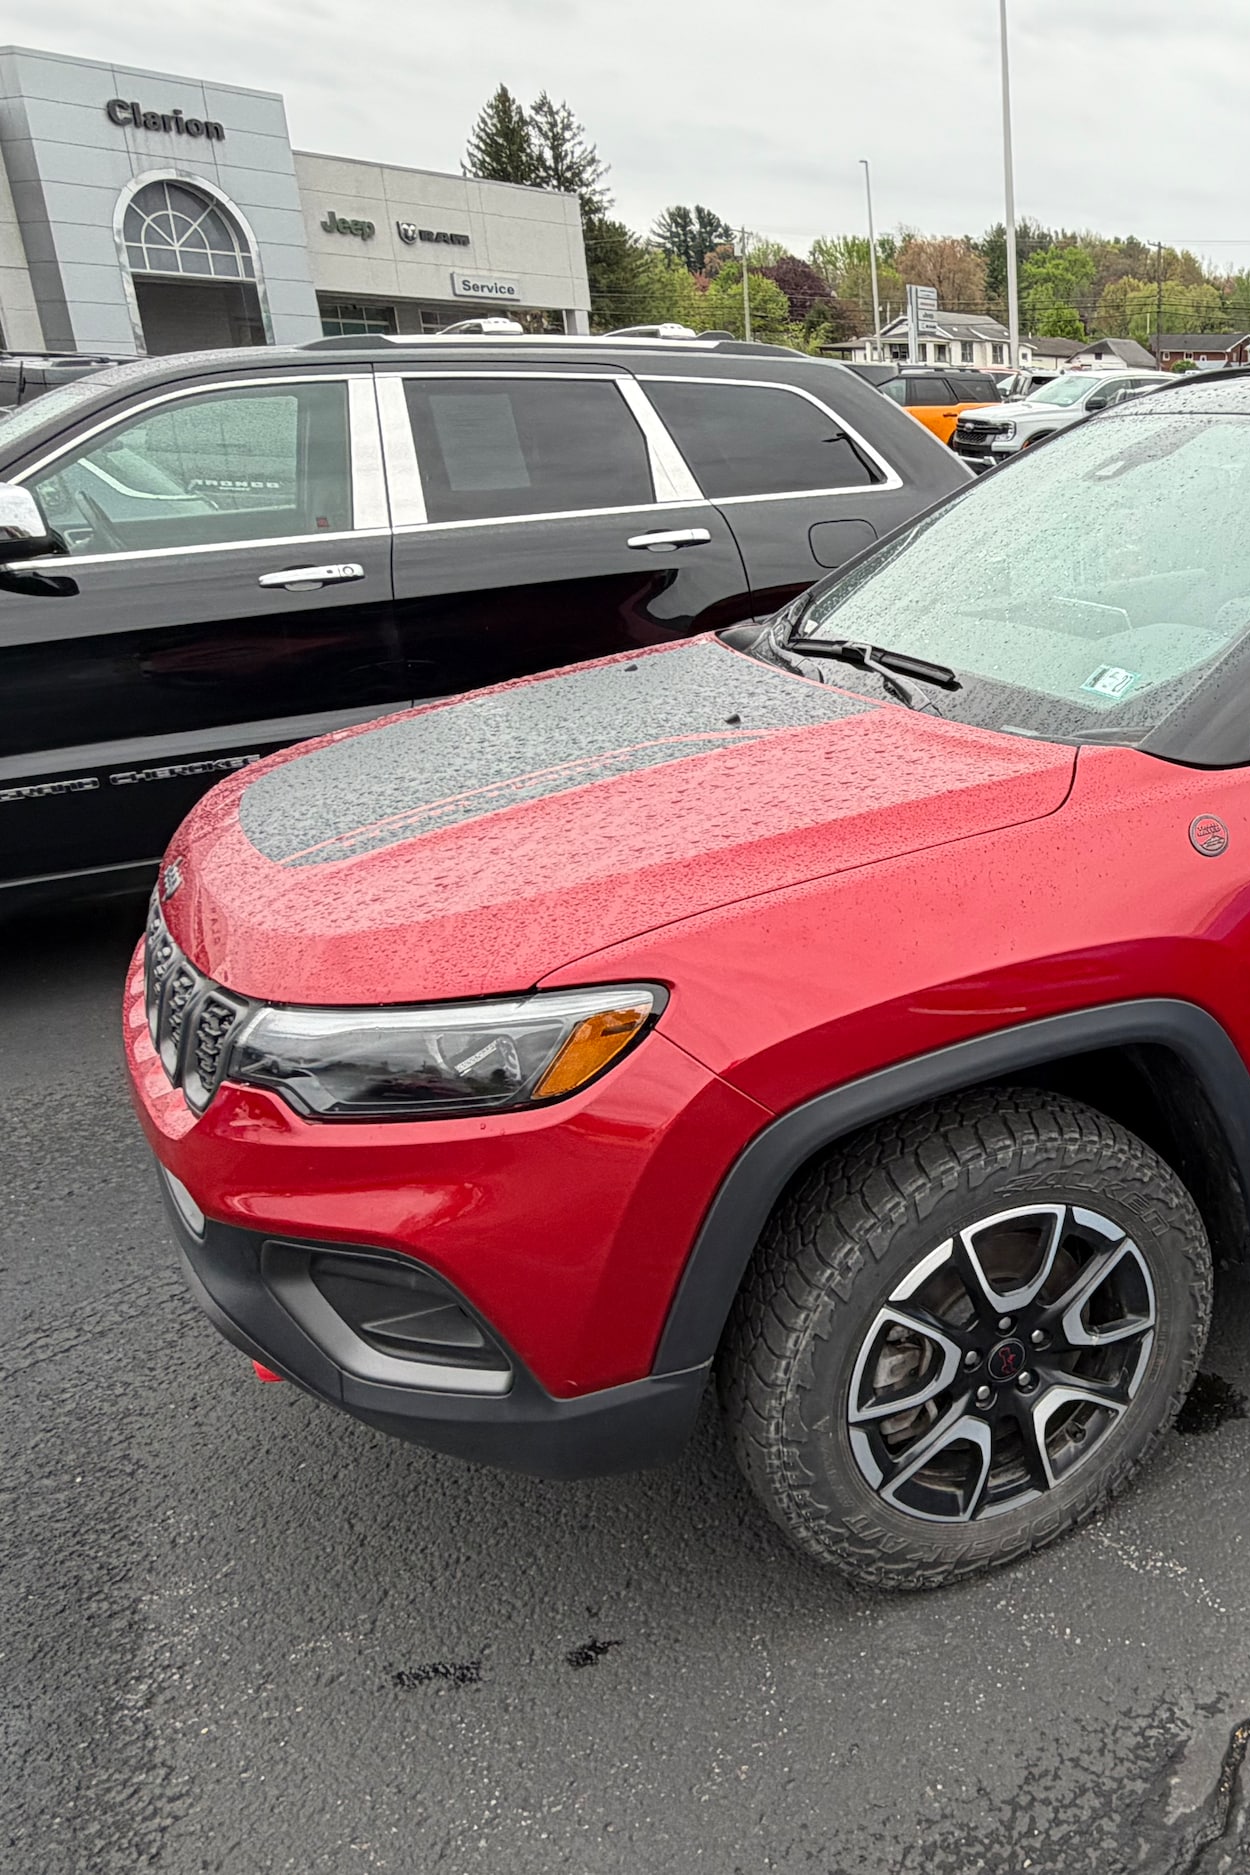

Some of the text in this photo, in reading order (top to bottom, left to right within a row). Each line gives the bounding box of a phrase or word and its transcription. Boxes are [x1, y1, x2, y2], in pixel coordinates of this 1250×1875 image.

[106, 99, 226, 142] Clarion
[320, 211, 376, 241] Jeep
[418, 229, 470, 247] RAM
[462, 279, 515, 295] Service
